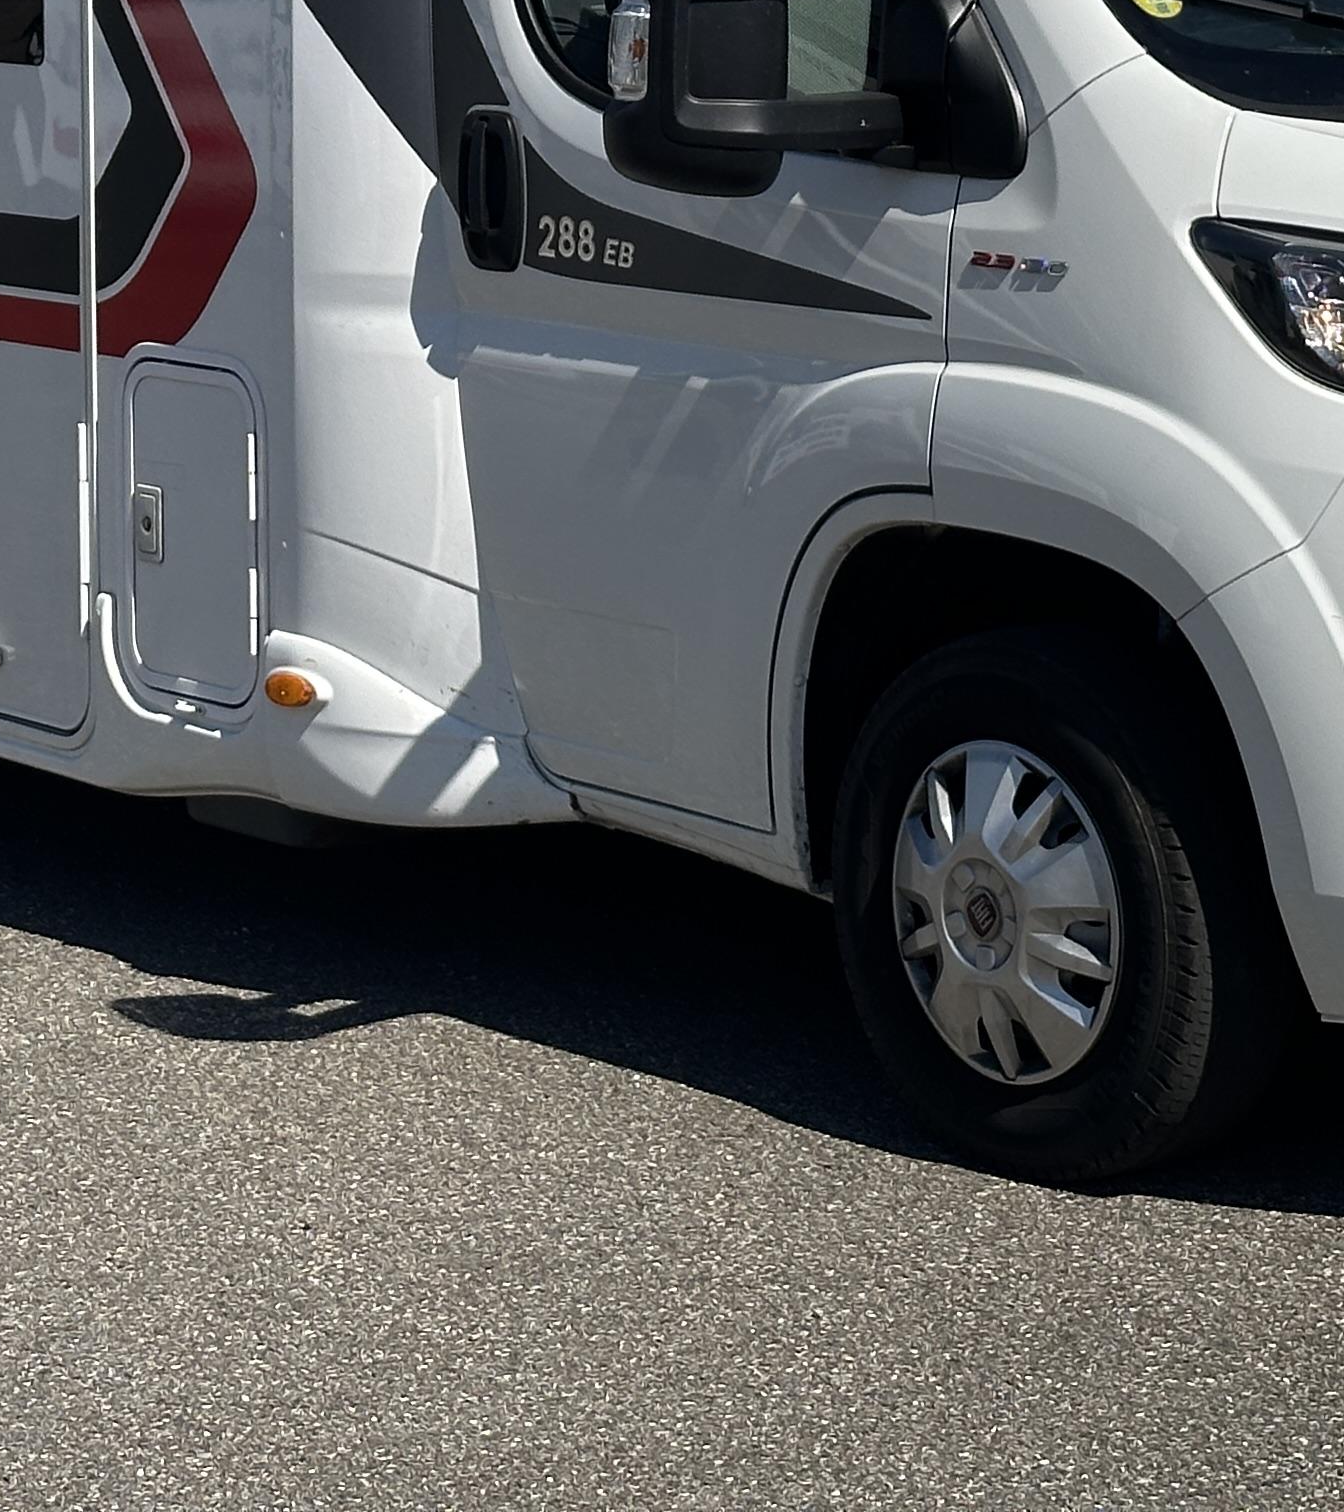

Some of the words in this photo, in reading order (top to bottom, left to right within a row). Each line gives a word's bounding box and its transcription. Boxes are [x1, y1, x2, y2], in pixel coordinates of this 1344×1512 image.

[538, 215, 595, 262] 288
[603, 237, 635, 268] EB
[970, 896, 993, 930] FIAT
